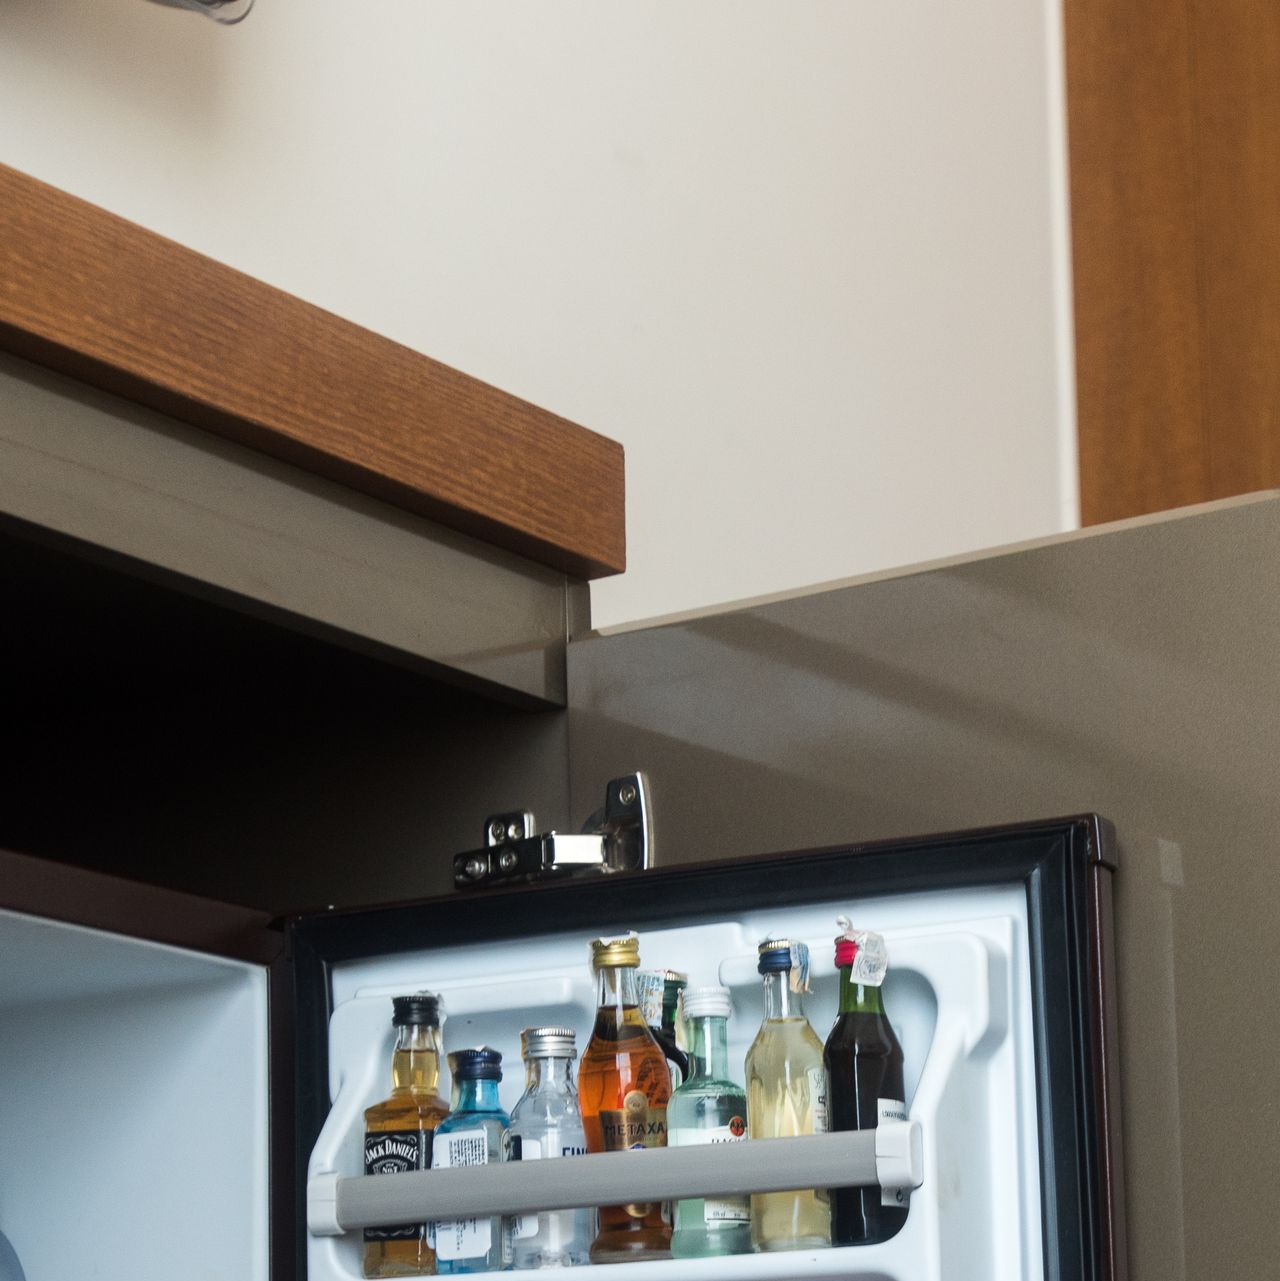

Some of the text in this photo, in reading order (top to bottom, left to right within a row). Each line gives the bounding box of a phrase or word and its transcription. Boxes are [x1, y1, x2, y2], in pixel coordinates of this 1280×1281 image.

[604, 1120, 667, 1137] METAXA
[365, 1144, 386, 1165] JACK
[385, 1139, 419, 1162] DANIEL'S
